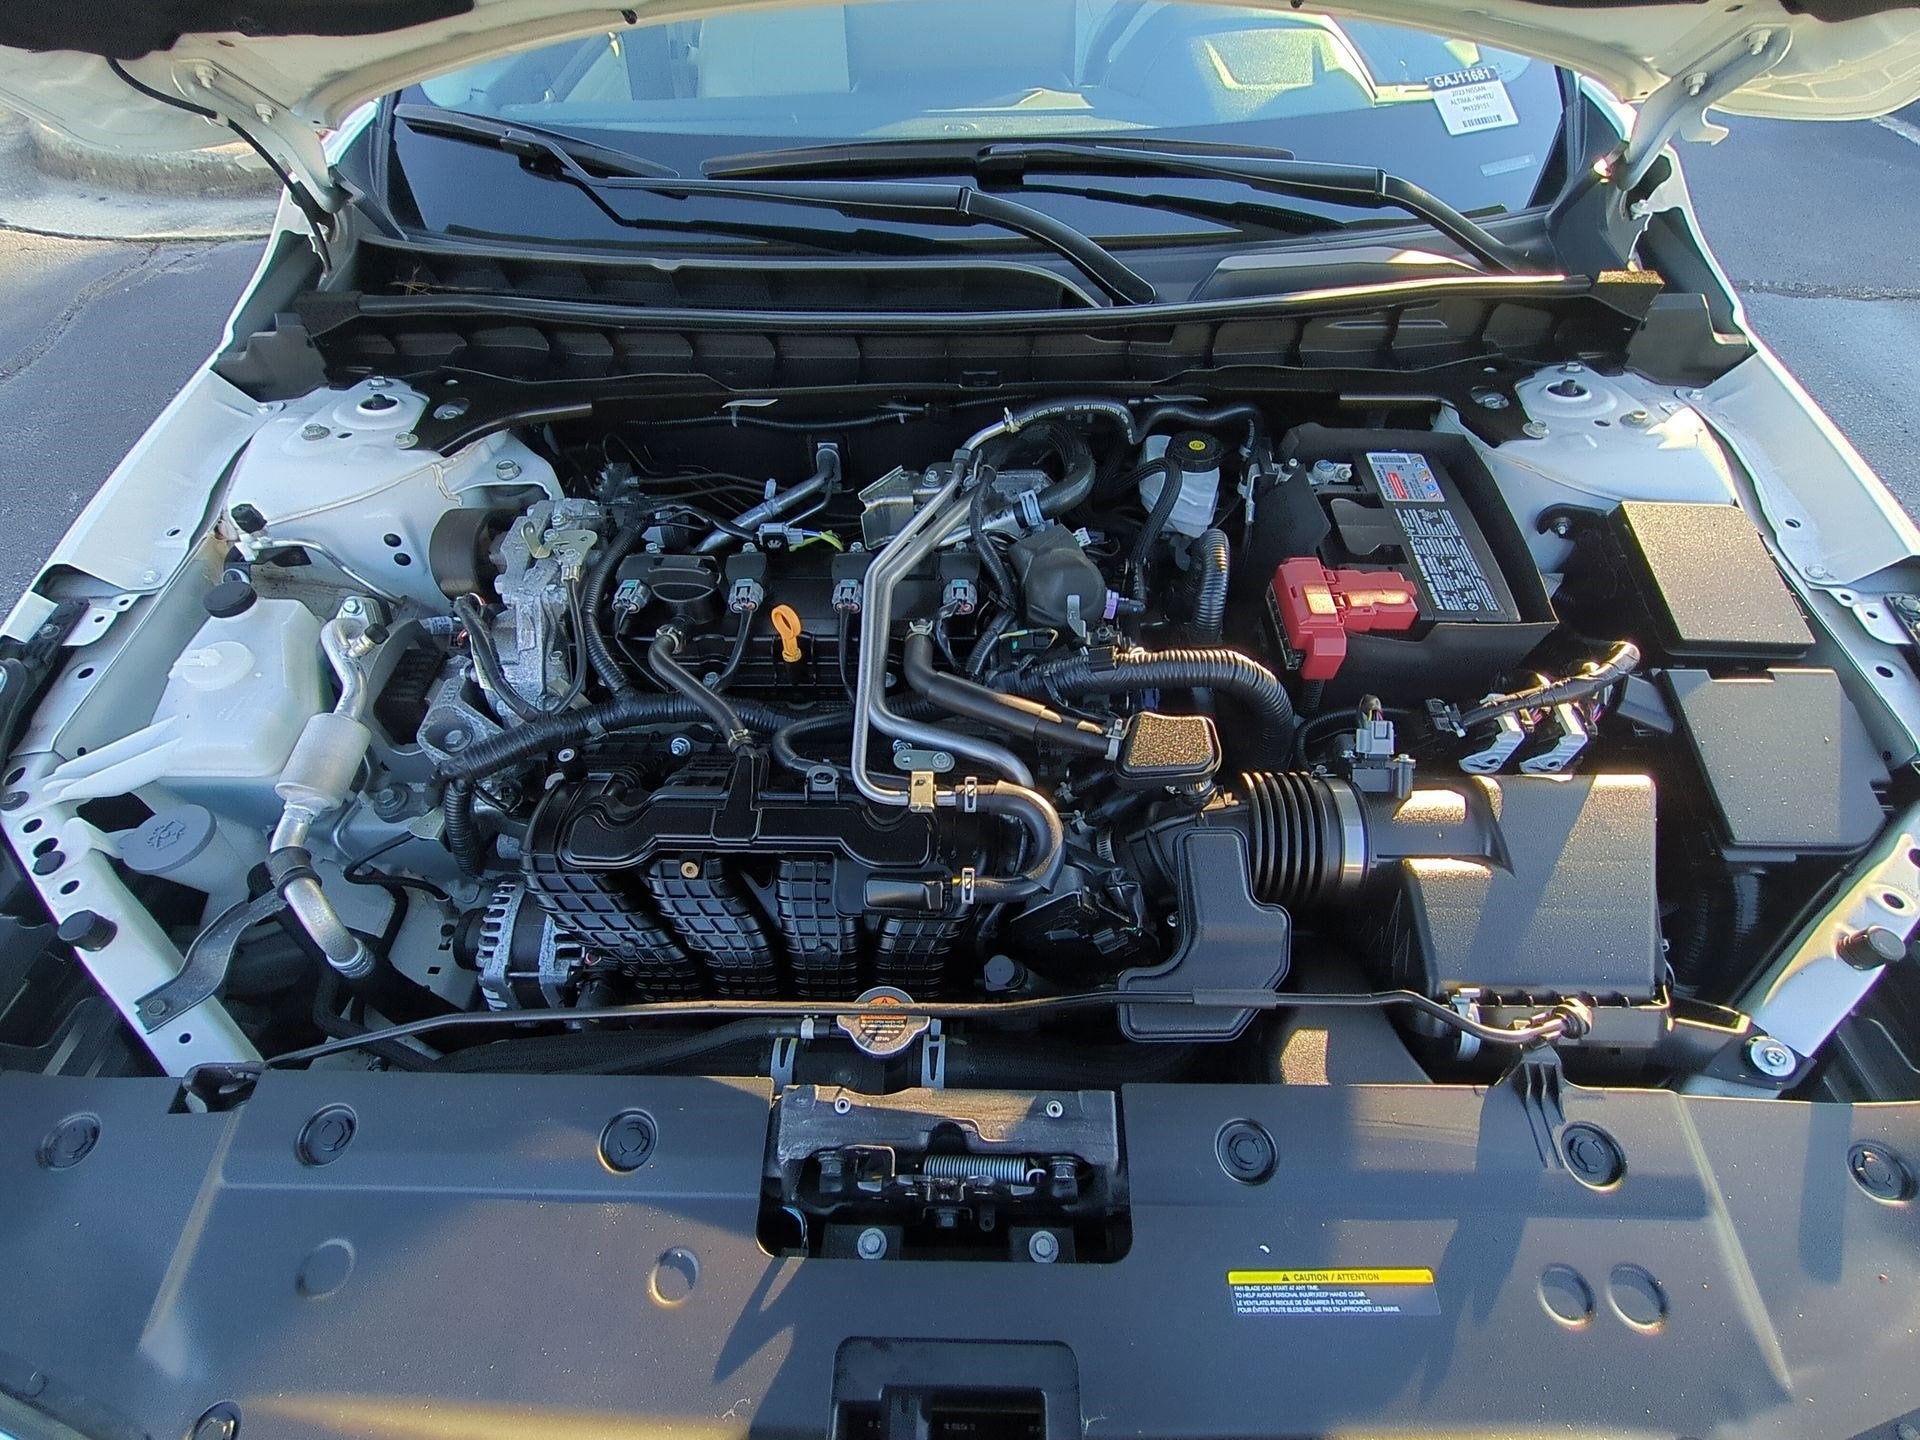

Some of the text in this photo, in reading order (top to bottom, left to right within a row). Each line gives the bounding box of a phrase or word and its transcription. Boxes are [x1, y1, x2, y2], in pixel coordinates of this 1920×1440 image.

[1433, 69, 1491, 88] GAJ11681
[1465, 86, 1487, 95] NISSAN
[1450, 97, 1472, 105] ALTIMA
[1293, 1273, 1329, 1281] CAUTION
[1337, 1273, 1379, 1281] ATTENTION
